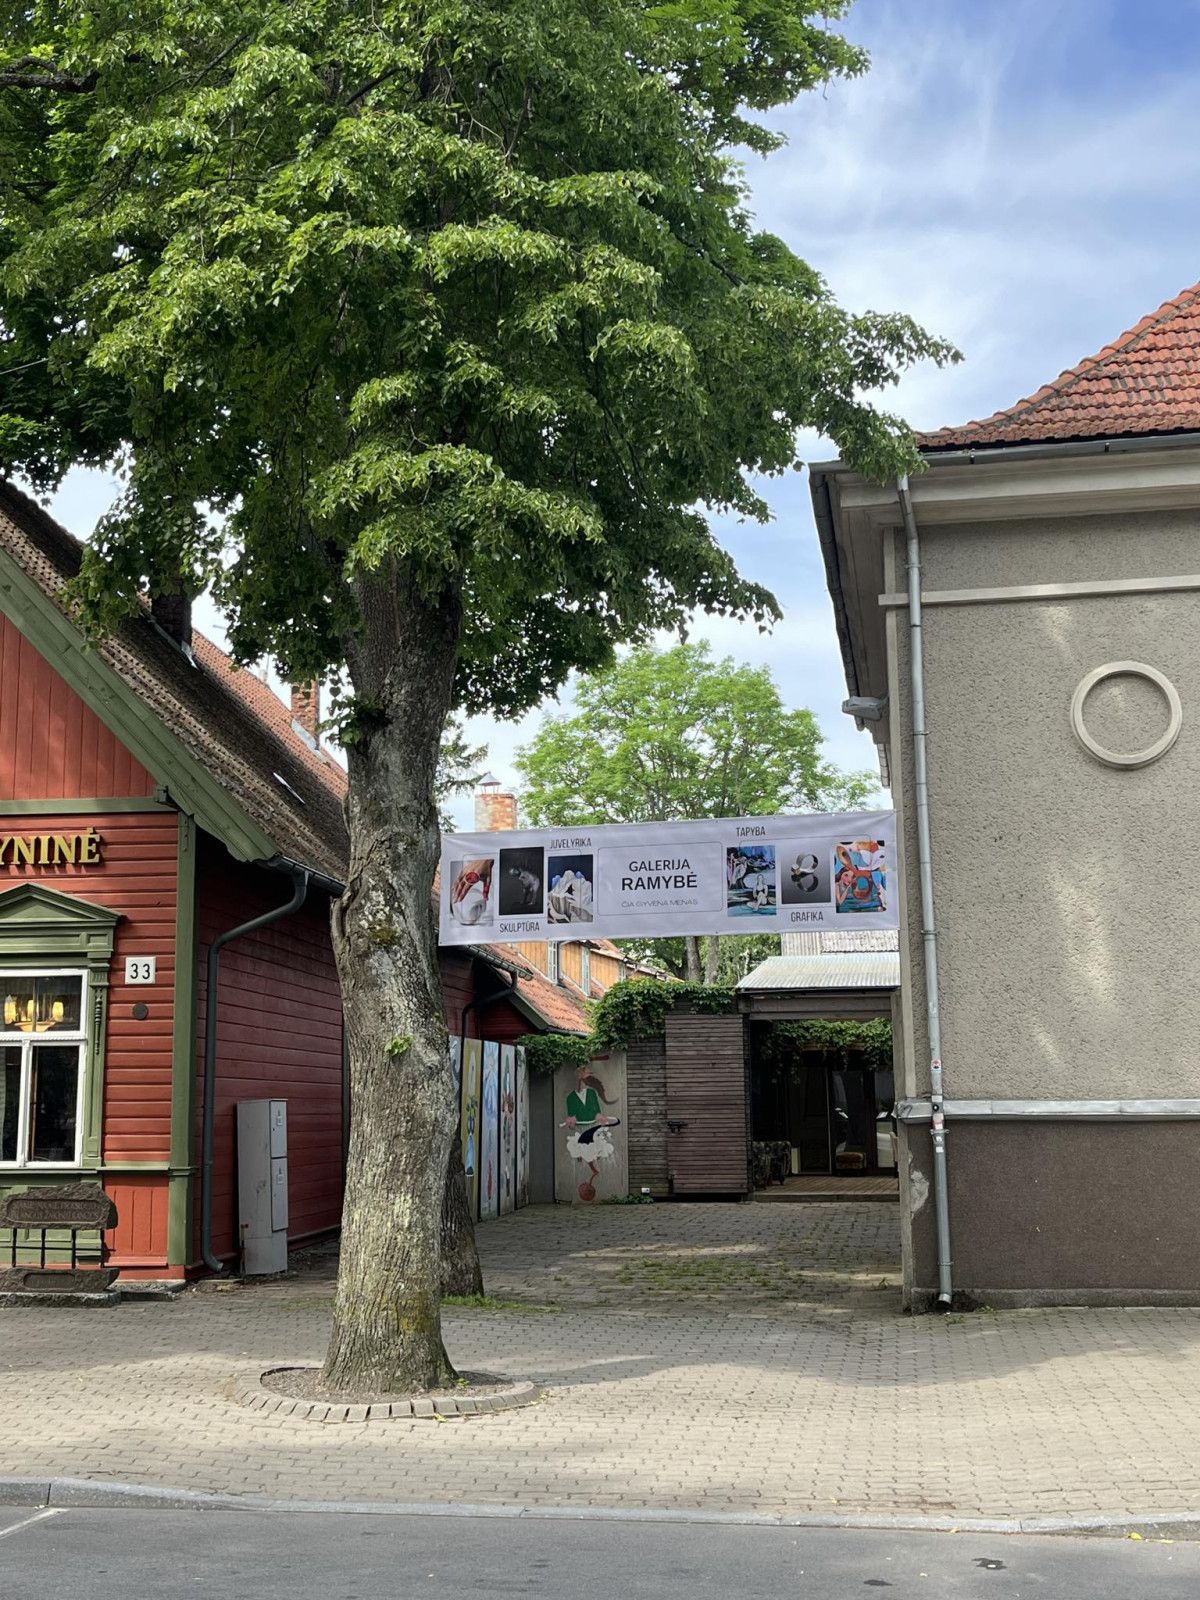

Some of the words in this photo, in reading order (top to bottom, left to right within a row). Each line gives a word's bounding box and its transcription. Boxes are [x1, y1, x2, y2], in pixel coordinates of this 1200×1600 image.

[736, 826, 766, 837] TAPYBA
[550, 837, 592, 849] JUVELYRIKA
[629, 858, 691, 872] GALERIJA
[621, 871, 698, 891] RAMYBĖ
[790, 911, 824, 923] GRAFIKA
[499, 921, 540, 933] SKULPTŪRA
[130, 963, 151, 980] 33
